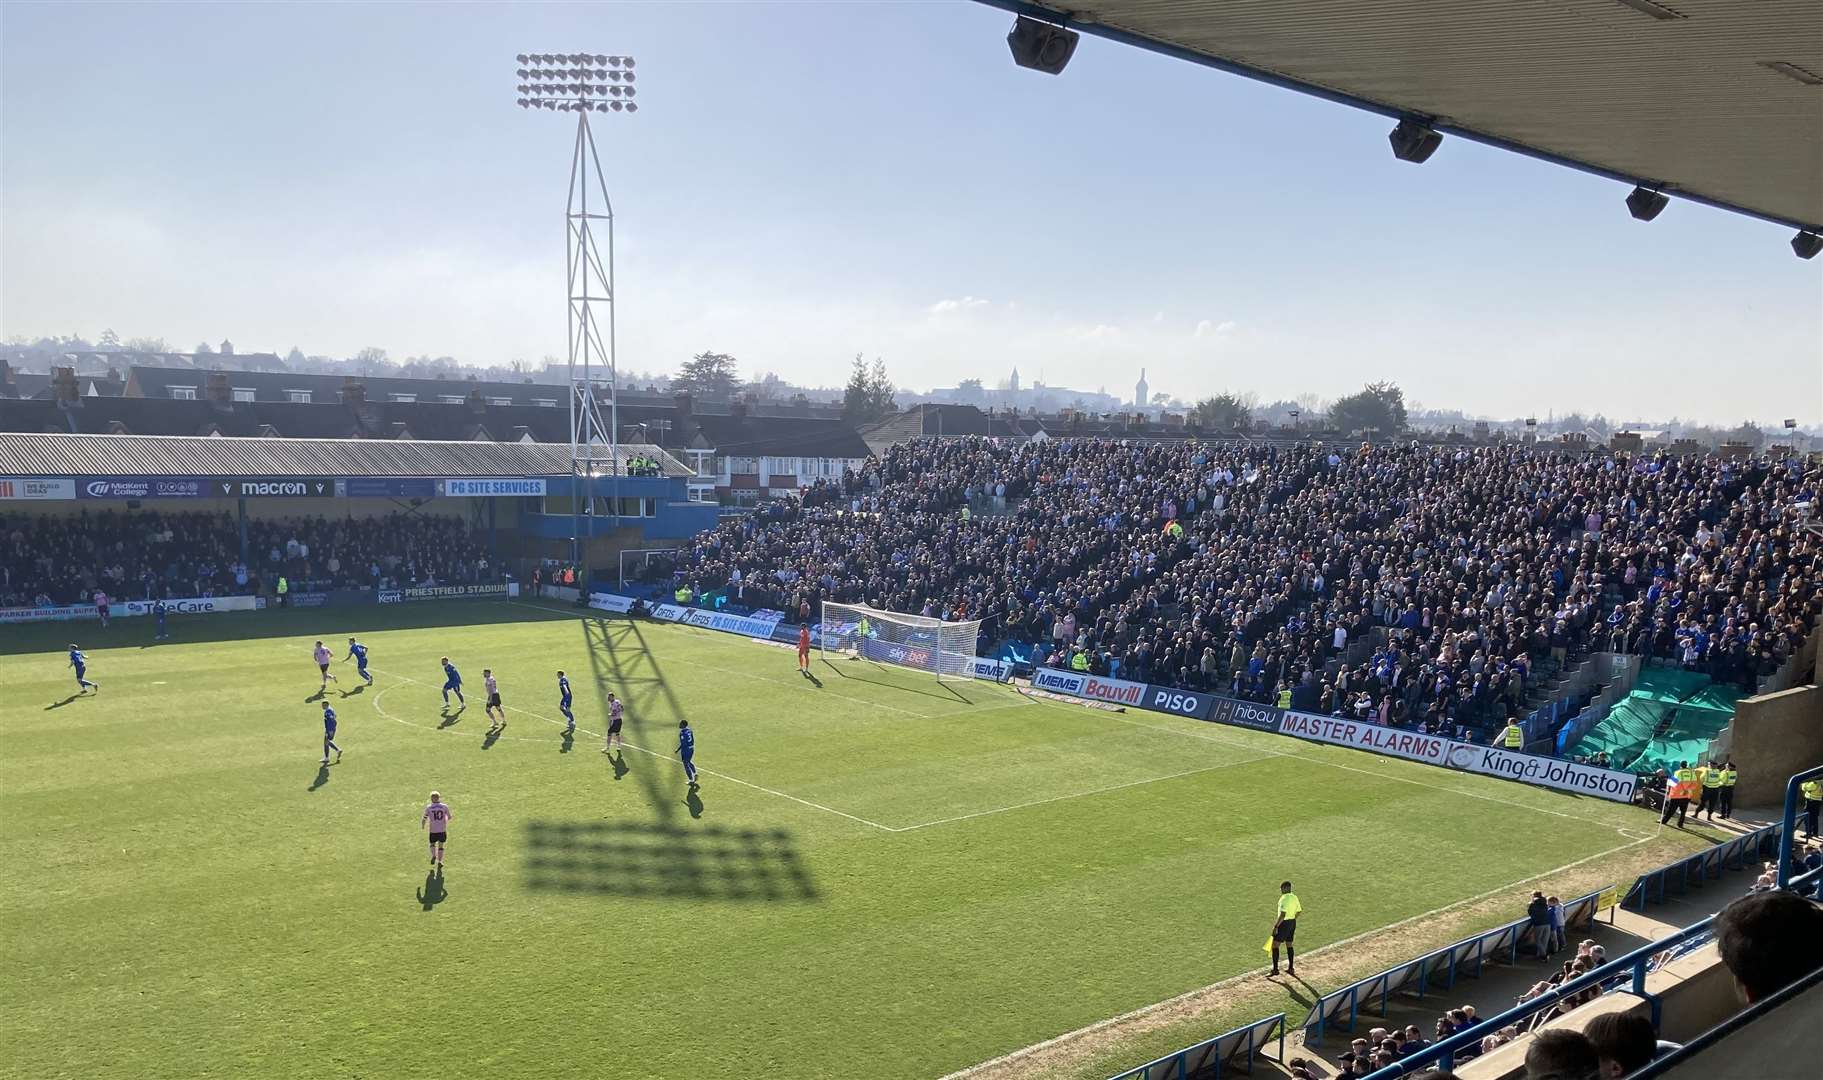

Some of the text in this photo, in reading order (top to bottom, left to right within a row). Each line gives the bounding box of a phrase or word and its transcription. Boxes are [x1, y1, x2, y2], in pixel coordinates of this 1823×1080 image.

[241, 482, 307, 495] macron
[451, 481, 542, 493] PG SITE SERVICES
[405, 586, 465, 597] PRIESTFIELD
[656, 608, 676, 619] DFDS
[691, 614, 711, 625] DFDS
[721, 618, 739, 632] SITE
[737, 620, 773, 637] SERVICES
[888, 647, 930, 664] sky bet
[1038, 674, 1080, 691] MEMS
[1085, 679, 1142, 704] Bauvill
[1154, 691, 1198, 713] PISO
[1234, 703, 1277, 723] hibau
[1282, 714, 1357, 743] MASTER
[1359, 728, 1442, 758] ALARMS
[431, 810, 444, 821] 10
